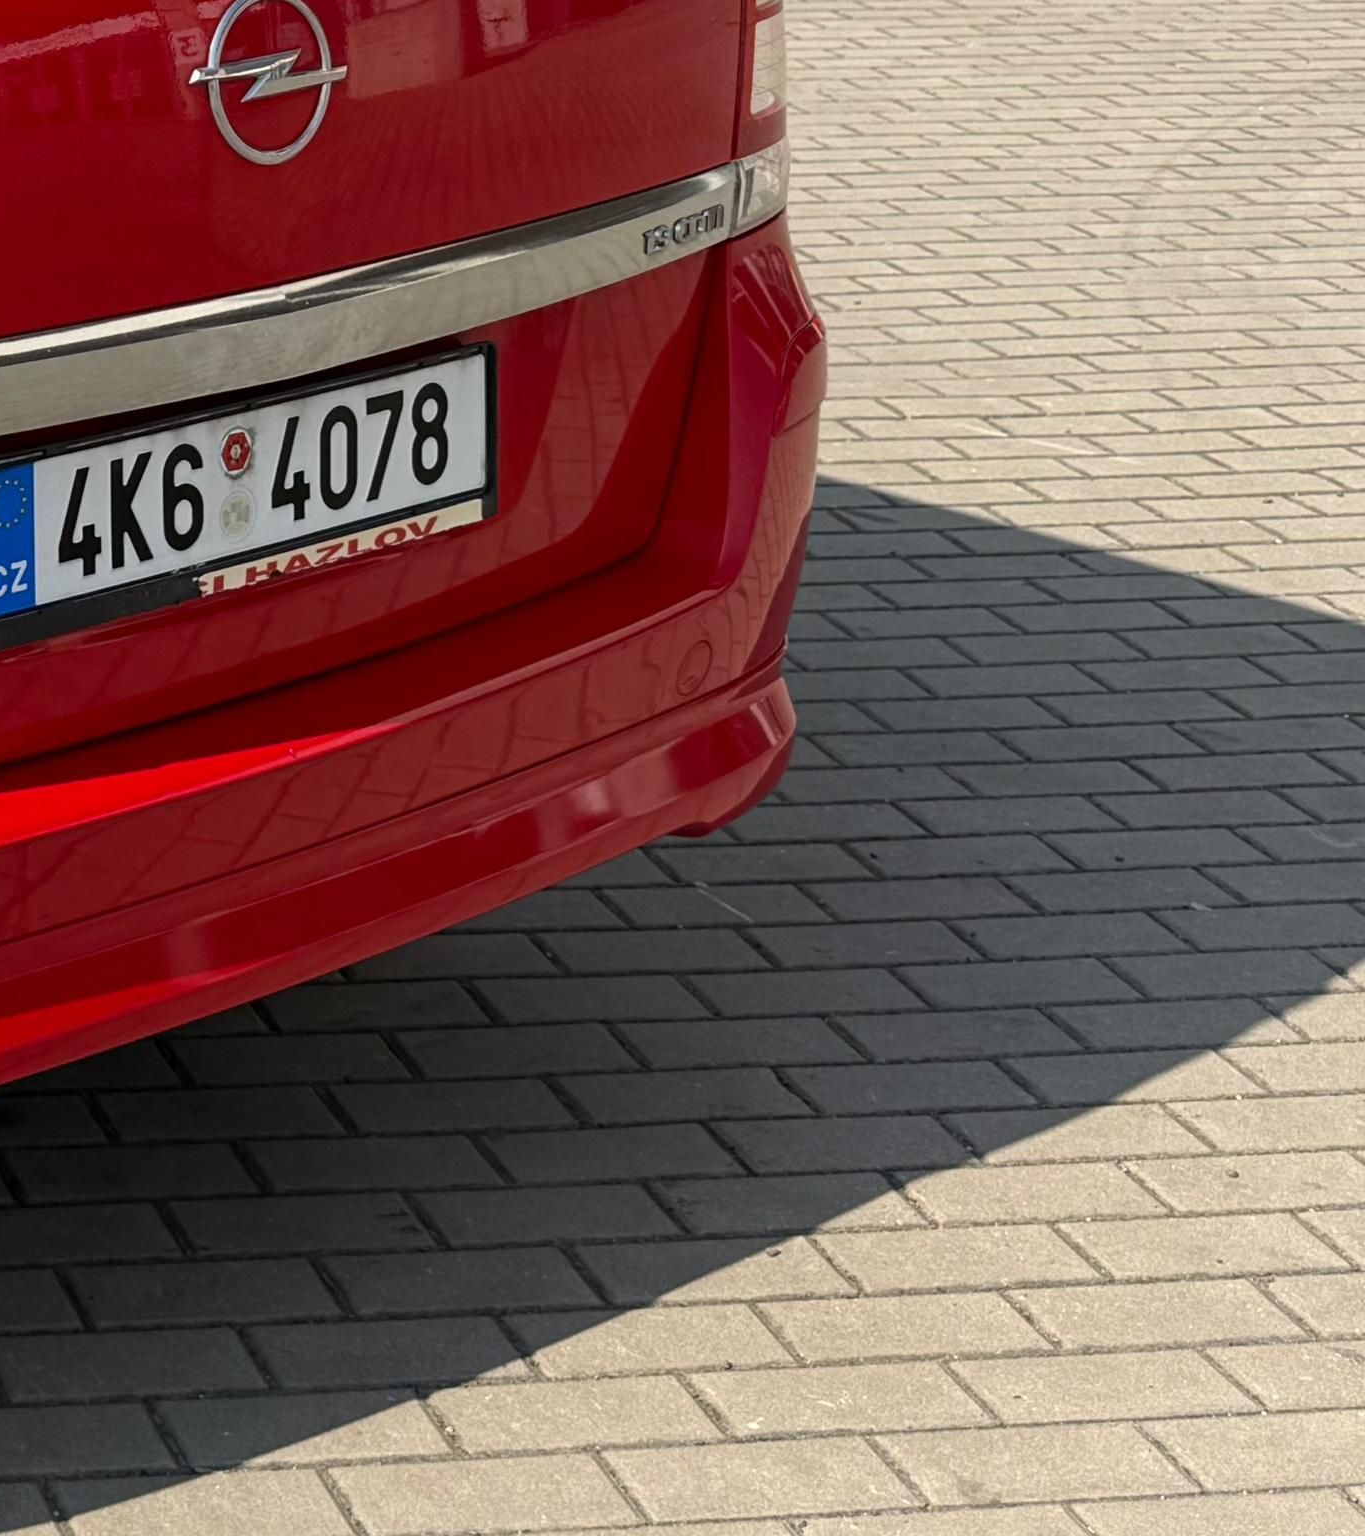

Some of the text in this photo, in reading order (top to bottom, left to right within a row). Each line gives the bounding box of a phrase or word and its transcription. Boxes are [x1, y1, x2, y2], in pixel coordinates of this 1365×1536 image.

[58, 382, 448, 577] 4K6 4078
[245, 516, 438, 584] HAZLOV
